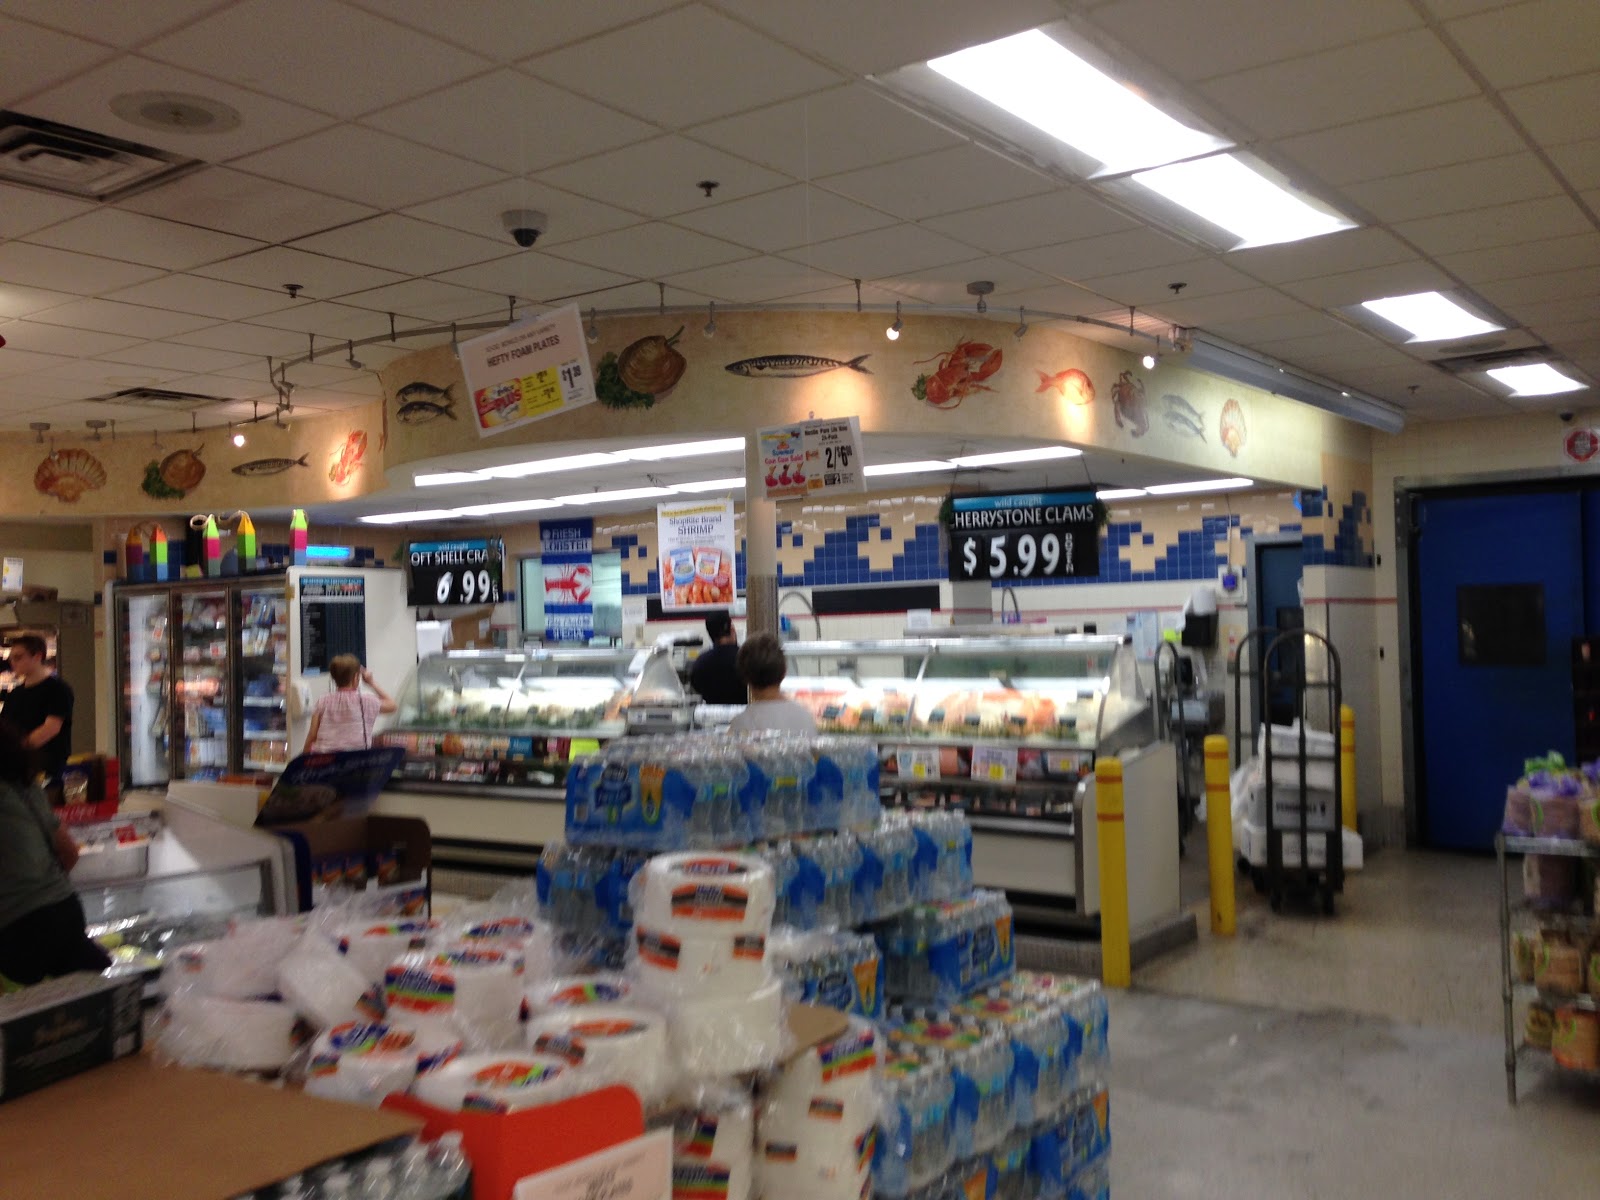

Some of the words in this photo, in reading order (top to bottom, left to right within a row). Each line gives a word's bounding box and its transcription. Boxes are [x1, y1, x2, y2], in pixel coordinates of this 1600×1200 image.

[487, 352, 510, 367] HEFTY
[511, 346, 534, 360] FOAM
[533, 334, 561, 351] PLATES
[994, 498, 1012, 508] wild
[1013, 496, 1042, 508] caught
[701, 514, 722, 524] Brand
[1045, 504, 1094, 522] CLAMS
[552, 528, 581, 539] FRESH
[678, 524, 714, 535] SHRIMP
[410, 551, 432, 567] OFT
[435, 550, 465, 566] SHELL
